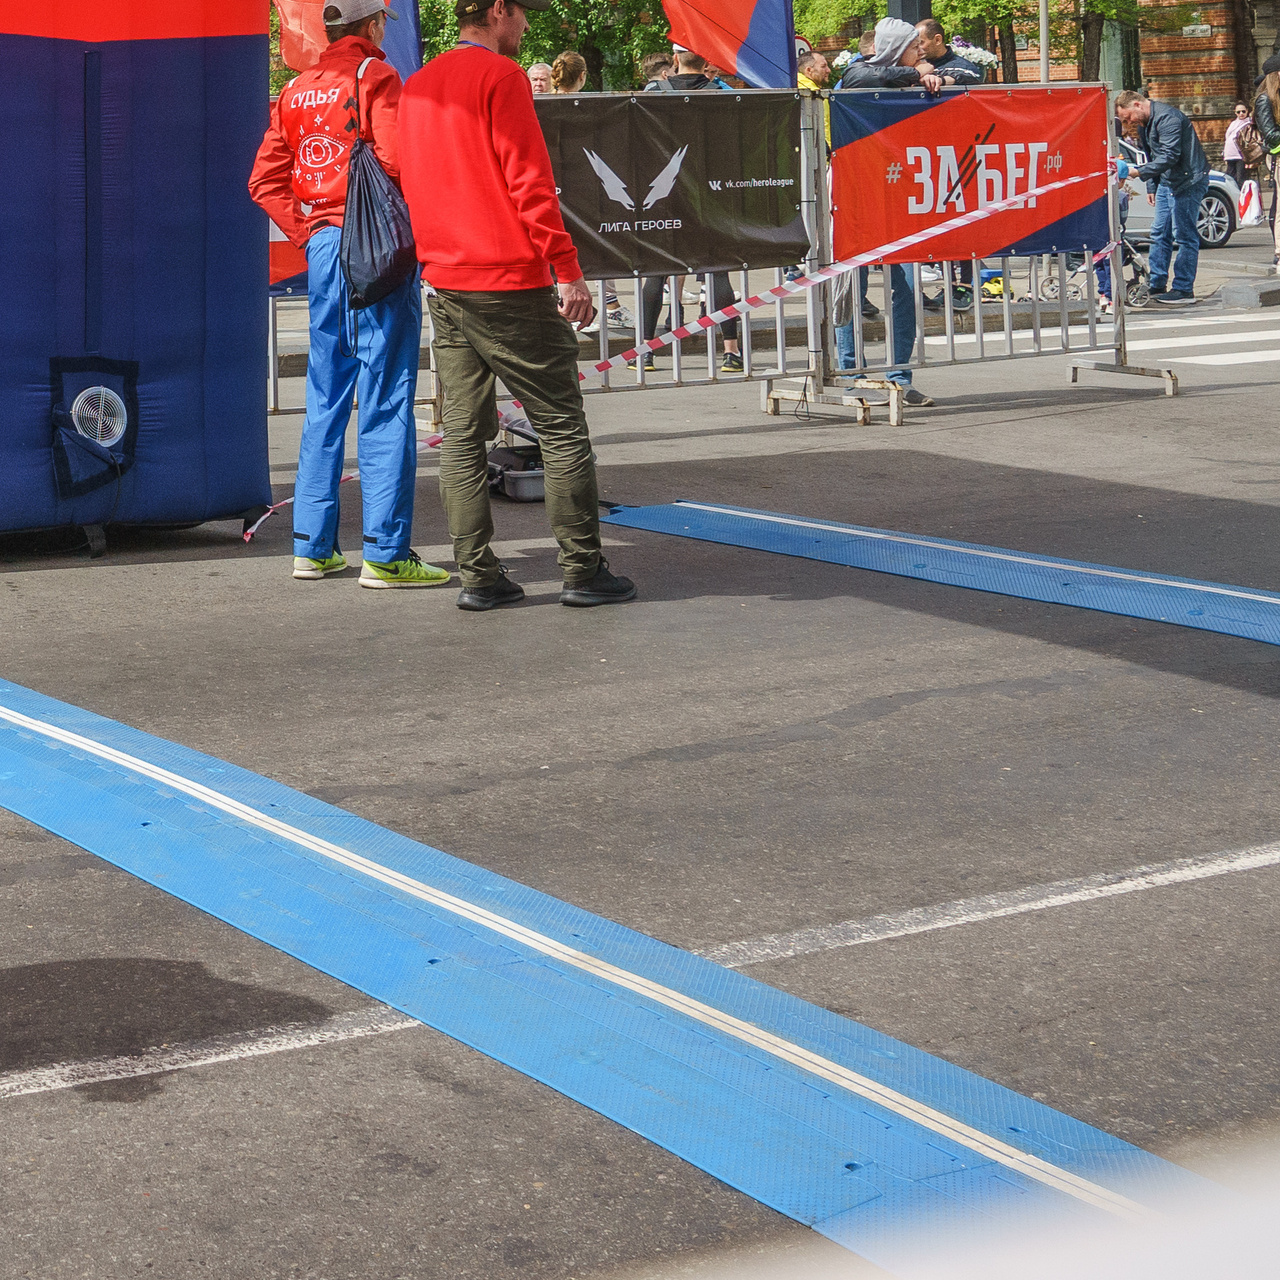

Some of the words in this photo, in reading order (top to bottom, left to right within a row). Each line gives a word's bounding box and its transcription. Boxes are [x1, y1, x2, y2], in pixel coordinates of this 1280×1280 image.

[290, 87, 341, 110] СУДЬЯ
[725, 177, 795, 189] vk.com/heroleague
[598, 221, 631, 233] ЛИГА
[634, 219, 682, 231] ГЕРОЕВ
